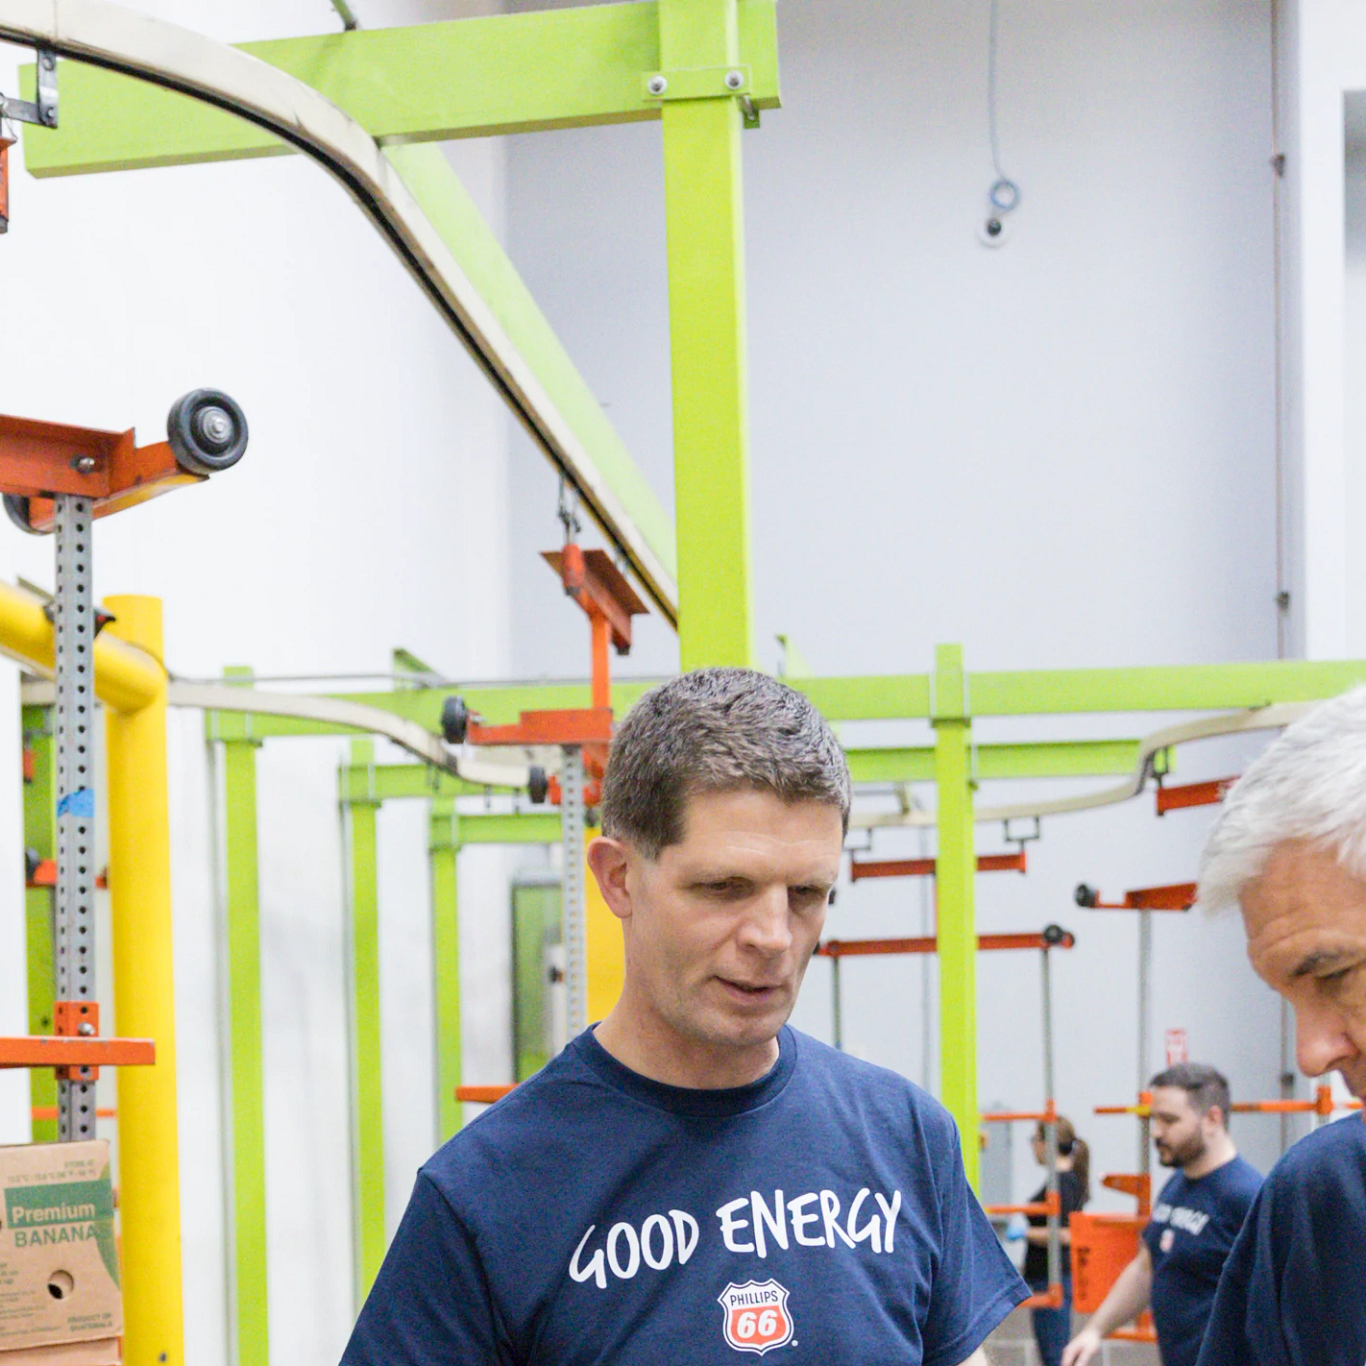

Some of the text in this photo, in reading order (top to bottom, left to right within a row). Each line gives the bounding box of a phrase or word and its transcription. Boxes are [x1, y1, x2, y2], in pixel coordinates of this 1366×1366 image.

[11, 1202, 96, 1224] Premium
[569, 1187, 902, 1289] GOOD ENERGY
[729, 1290, 778, 1306] PHILLIPS
[736, 1309, 778, 1339] 66
